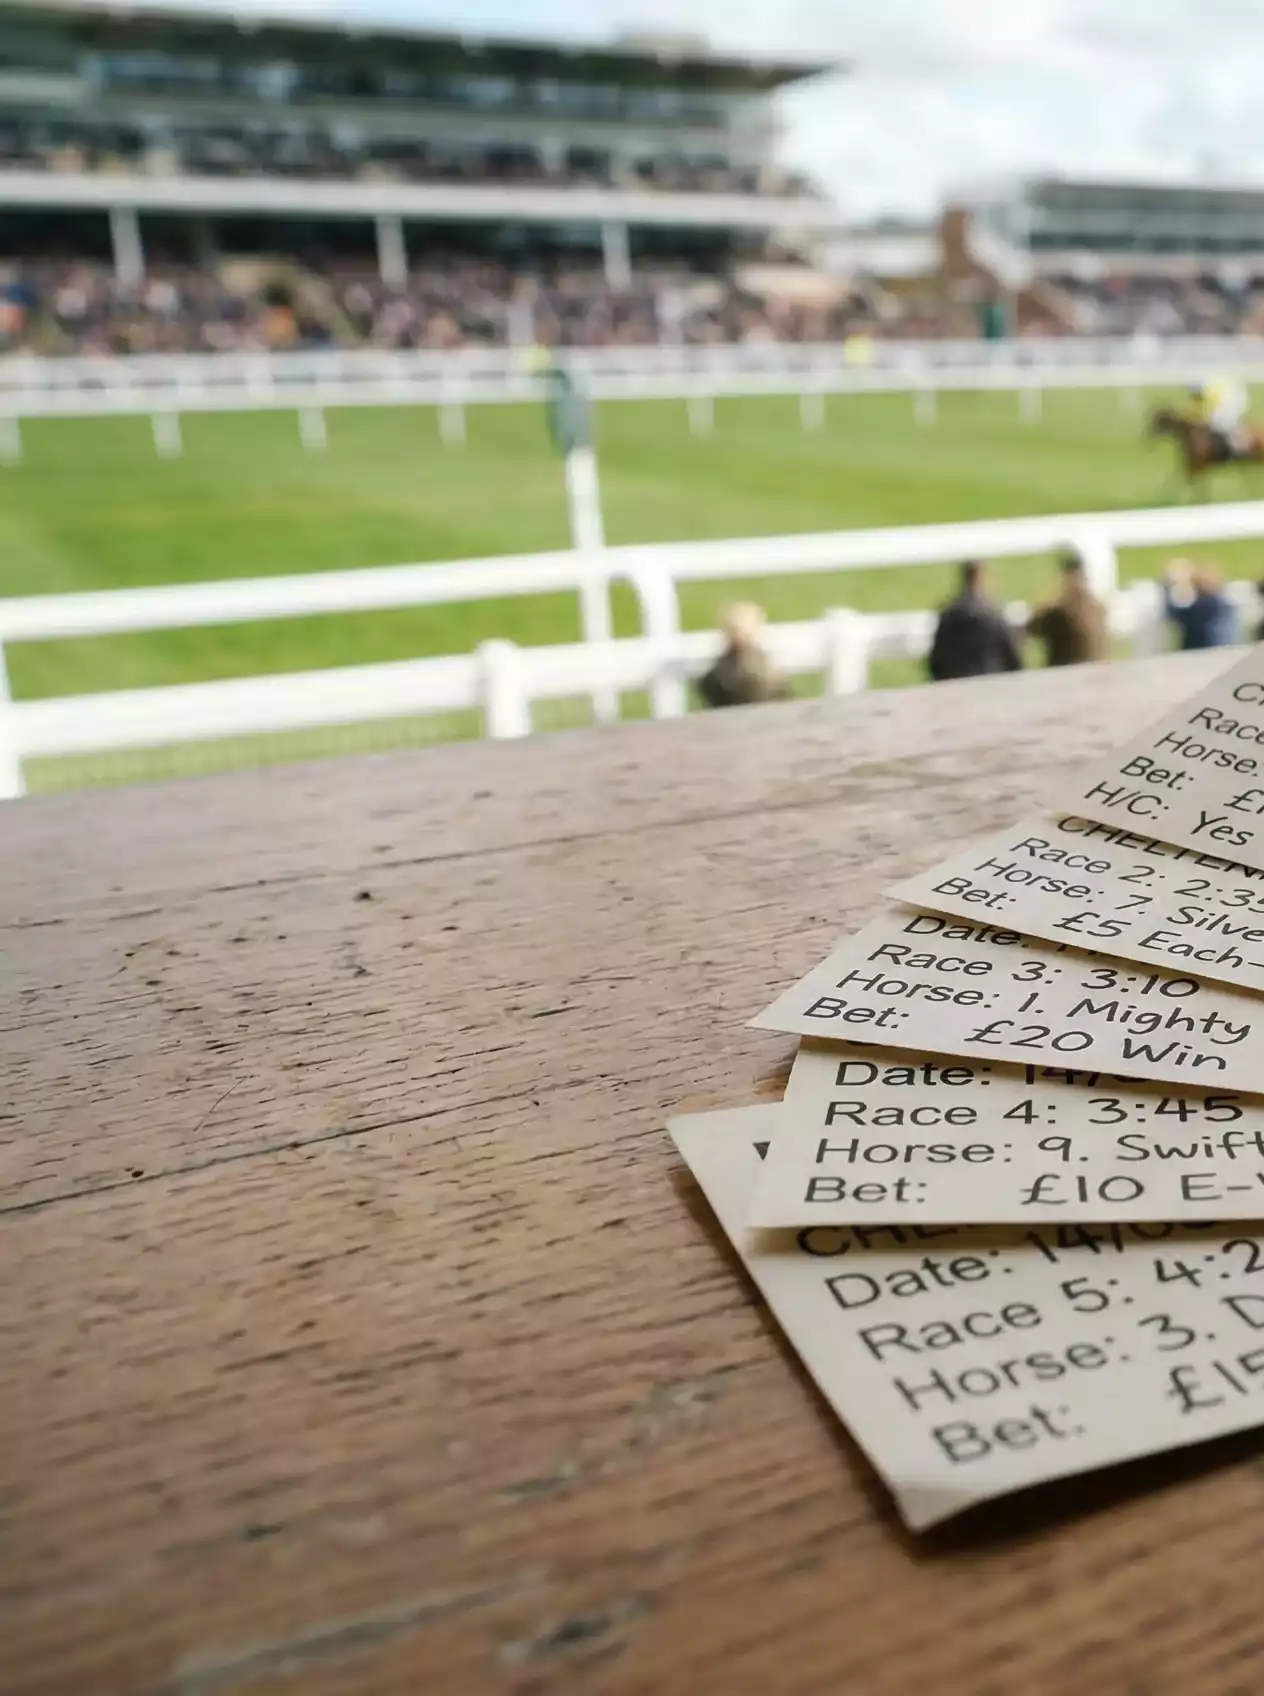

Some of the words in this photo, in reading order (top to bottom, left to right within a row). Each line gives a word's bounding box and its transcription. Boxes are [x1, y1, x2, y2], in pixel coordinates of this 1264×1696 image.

[1120, 756, 1195, 790] Bet:
[1084, 781, 1169, 820] H/C:
[1188, 810, 1254, 846] Yes
[974, 857, 1105, 903] Horse:
[1114, 894, 1155, 914] 7.
[1009, 837, 1112, 874] Race
[1118, 865, 1165, 887] 2:
[931, 877, 1017, 911] Bet:
[1052, 911, 1132, 938] £5
[867, 943, 993, 975] Race
[1011, 961, 1062, 984] 3:
[1081, 968, 1200, 998] 3:10
[803, 996, 910, 1029] Bet:
[964, 1019, 1094, 1052] £20
[1122, 1037, 1227, 1070] Win
[836, 969, 999, 1008] Horse:
[1018, 992, 1044, 1014] 1.
[1066, 998, 1251, 1045] Mighty
[835, 1061, 991, 1086] Date:
[824, 1100, 977, 1126] Race
[1002, 1099, 1056, 1125] 4:
[1087, 1097, 1244, 1124] 3:45
[815, 1138, 1012, 1164] Horse:
[1038, 1136, 1089, 1162] 9.
[804, 1177, 927, 1203] Bet:
[1019, 1174, 1145, 1205] £10
[824, 1250, 1014, 1310] Date:
[858, 1301, 1043, 1361] Race
[1061, 1277, 1134, 1313] 5:
[893, 1336, 1131, 1413] Horse:
[1137, 1313, 1216, 1352] 3.
[931, 1404, 1086, 1466] Bet:
